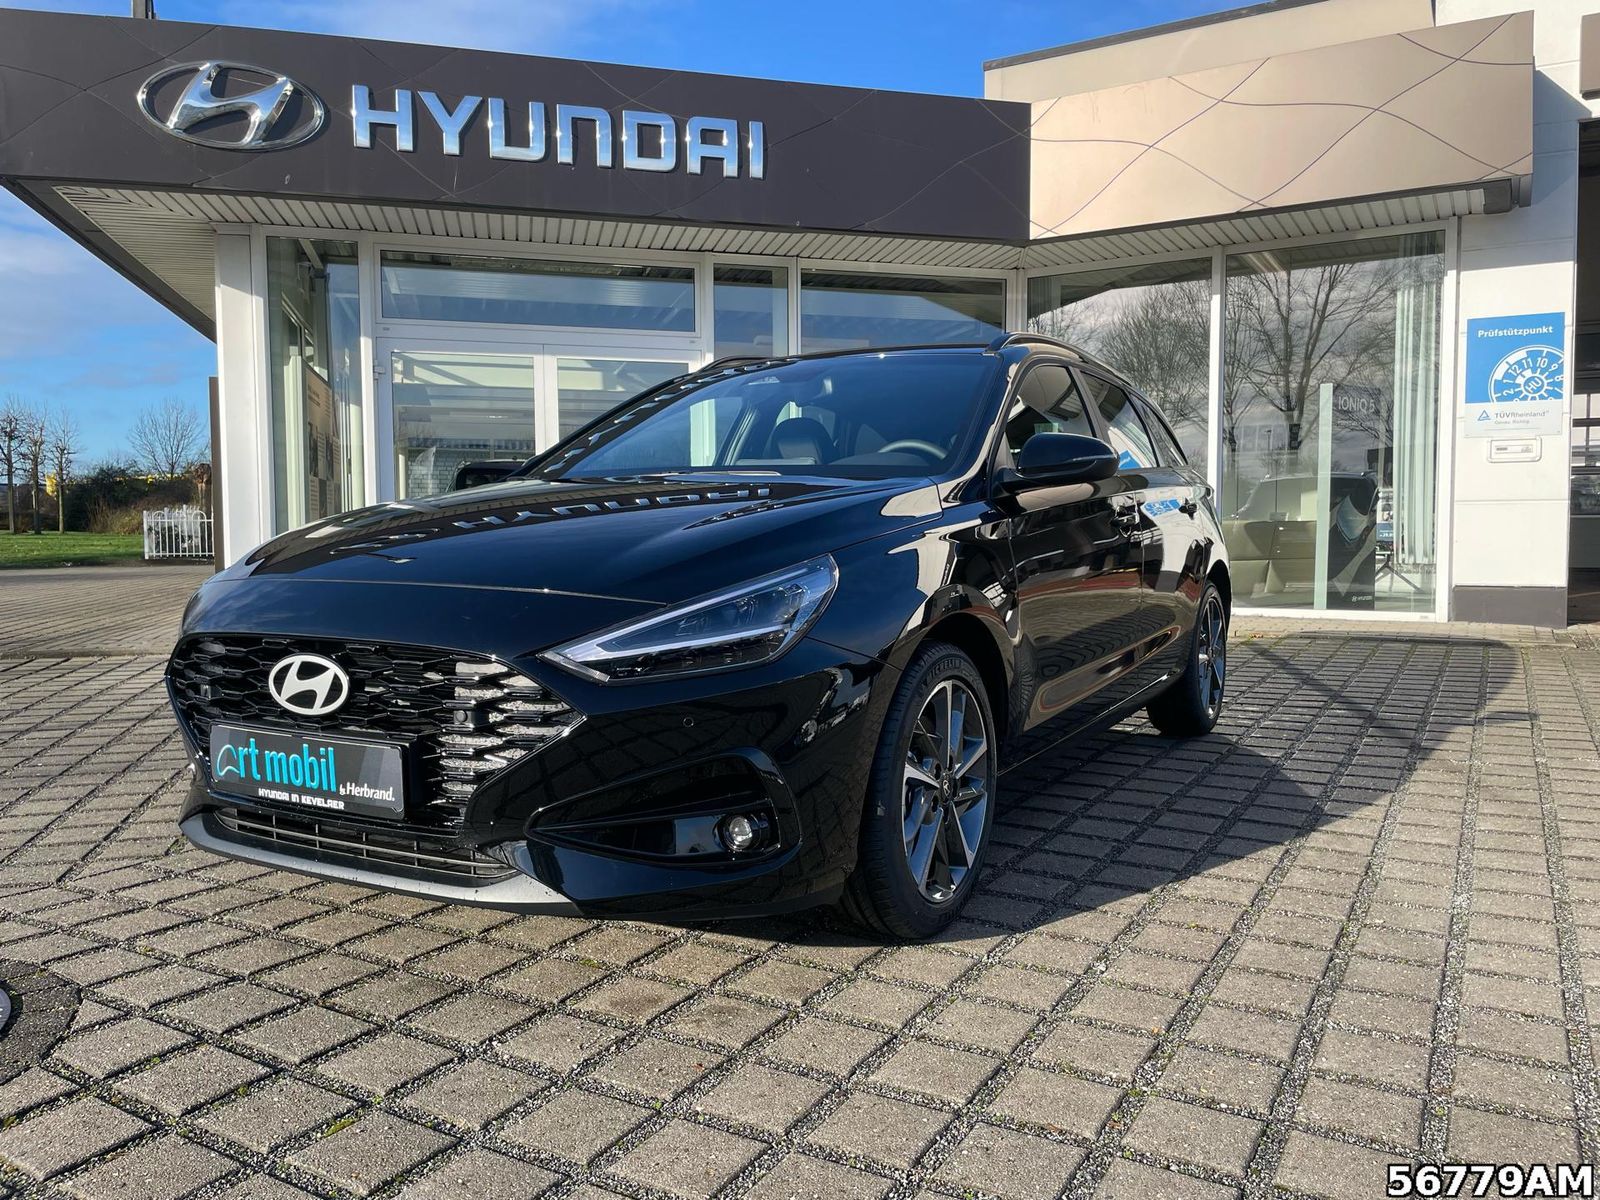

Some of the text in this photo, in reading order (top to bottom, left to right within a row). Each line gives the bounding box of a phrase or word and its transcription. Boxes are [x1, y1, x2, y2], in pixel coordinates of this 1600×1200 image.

[352, 84, 764, 179] HYUNDAI
[1478, 325, 1554, 338] Prüfstützpunkt
[1508, 364, 1523, 377] 12
[1522, 357, 1533, 369] 11
[1536, 357, 1548, 368] 10
[1548, 363, 1559, 372] 9
[1524, 377, 1543, 394] HU
[1338, 395, 1367, 414] IONIQ
[264, 743, 337, 793] mobil
[258, 788, 289, 802] HYUNDAI
[301, 795, 345, 810] KEVELAER
